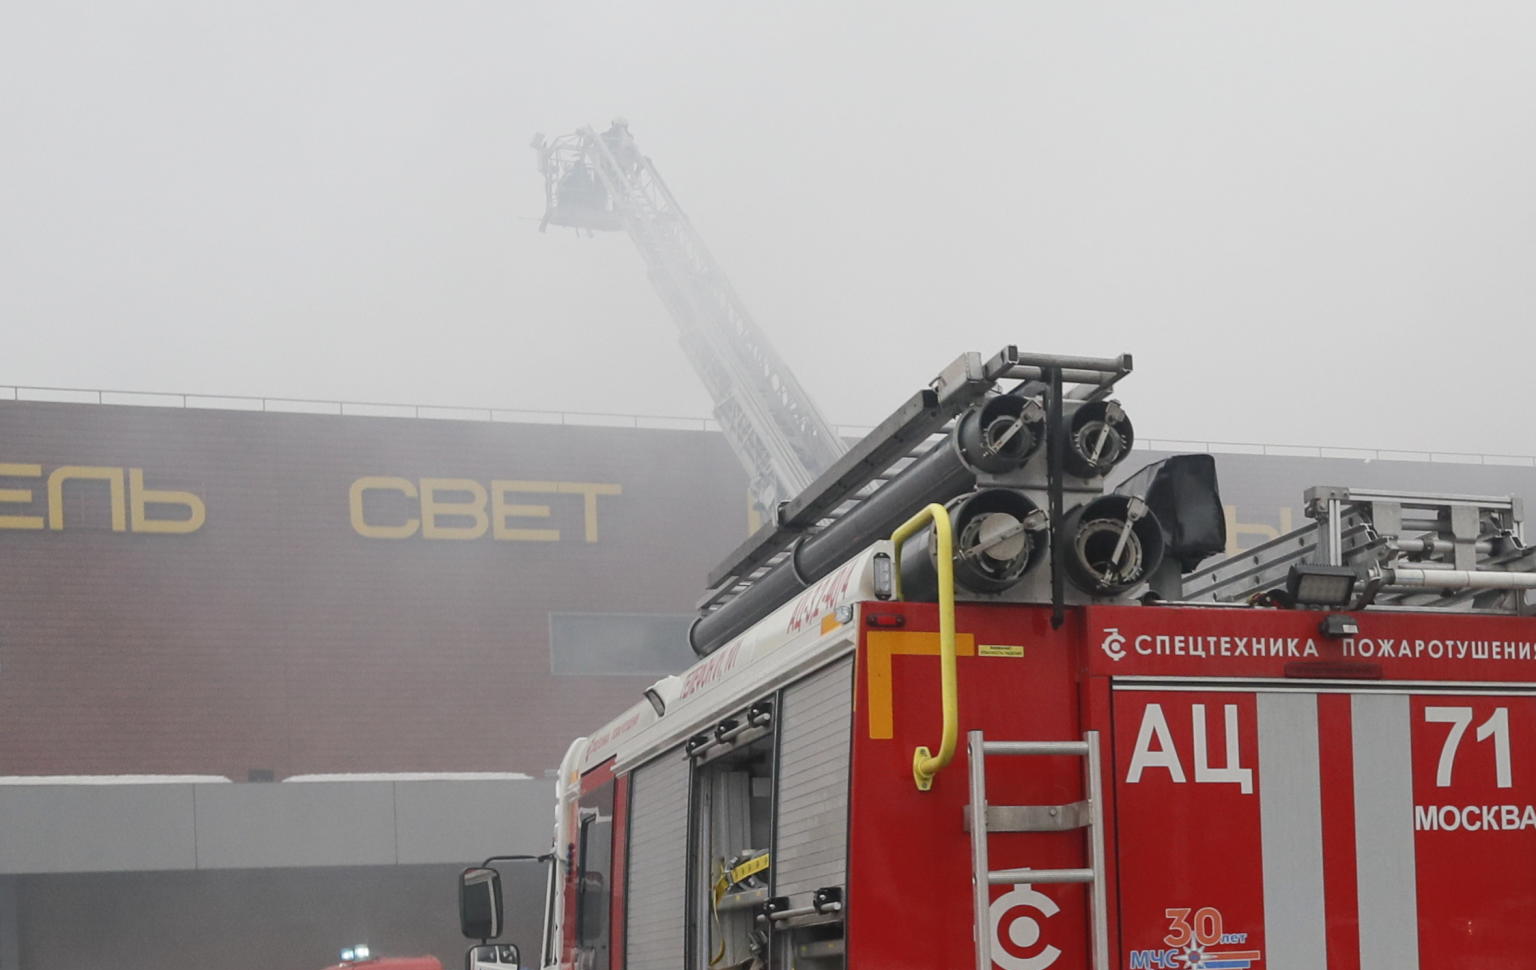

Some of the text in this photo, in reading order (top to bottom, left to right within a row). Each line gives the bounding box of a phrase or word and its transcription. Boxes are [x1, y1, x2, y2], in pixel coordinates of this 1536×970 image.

[348, 476, 622, 543] СВЕТ
[1135, 634, 1319, 658] СПЕЦТЕХНИКА
[1125, 703, 1513, 794] АЦ 71
[1163, 907, 1248, 948] 30 лет
[1129, 949, 1180, 970] МЧС
